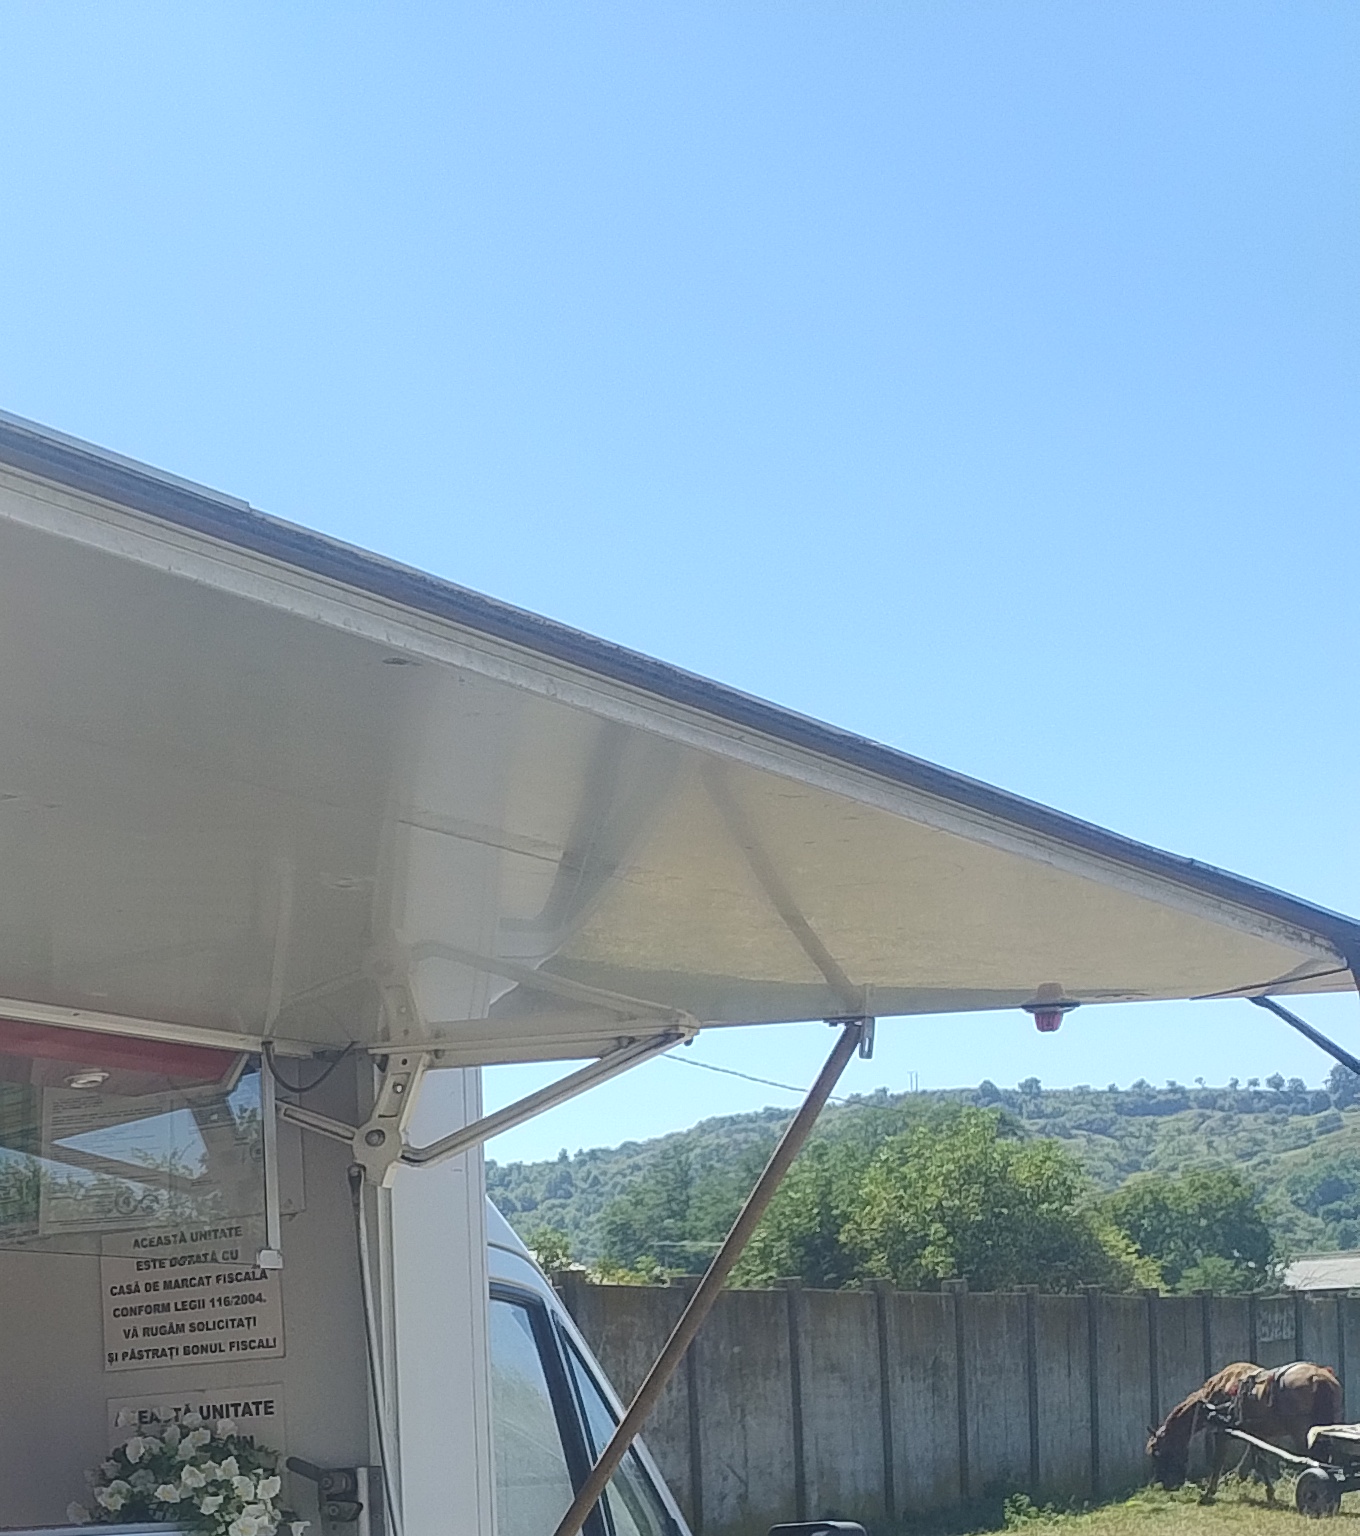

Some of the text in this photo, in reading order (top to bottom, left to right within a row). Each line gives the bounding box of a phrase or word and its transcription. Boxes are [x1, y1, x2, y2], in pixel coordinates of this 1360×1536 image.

[189, 1225, 244, 1243] UNITATE
[136, 1257, 167, 1272] ESTE
[221, 1249, 239, 1262] CU
[109, 1280, 141, 1297] CASĂ
[144, 1280, 160, 1293] DE
[162, 1275, 213, 1291] MARCAT
[112, 1302, 171, 1319] CONFORM
[174, 1298, 206, 1313] LEGII
[142, 1321, 186, 1338] RUGĂM
[182, 1341, 226, 1357] BONUL
[198, 1400, 275, 1421] UNITATE
